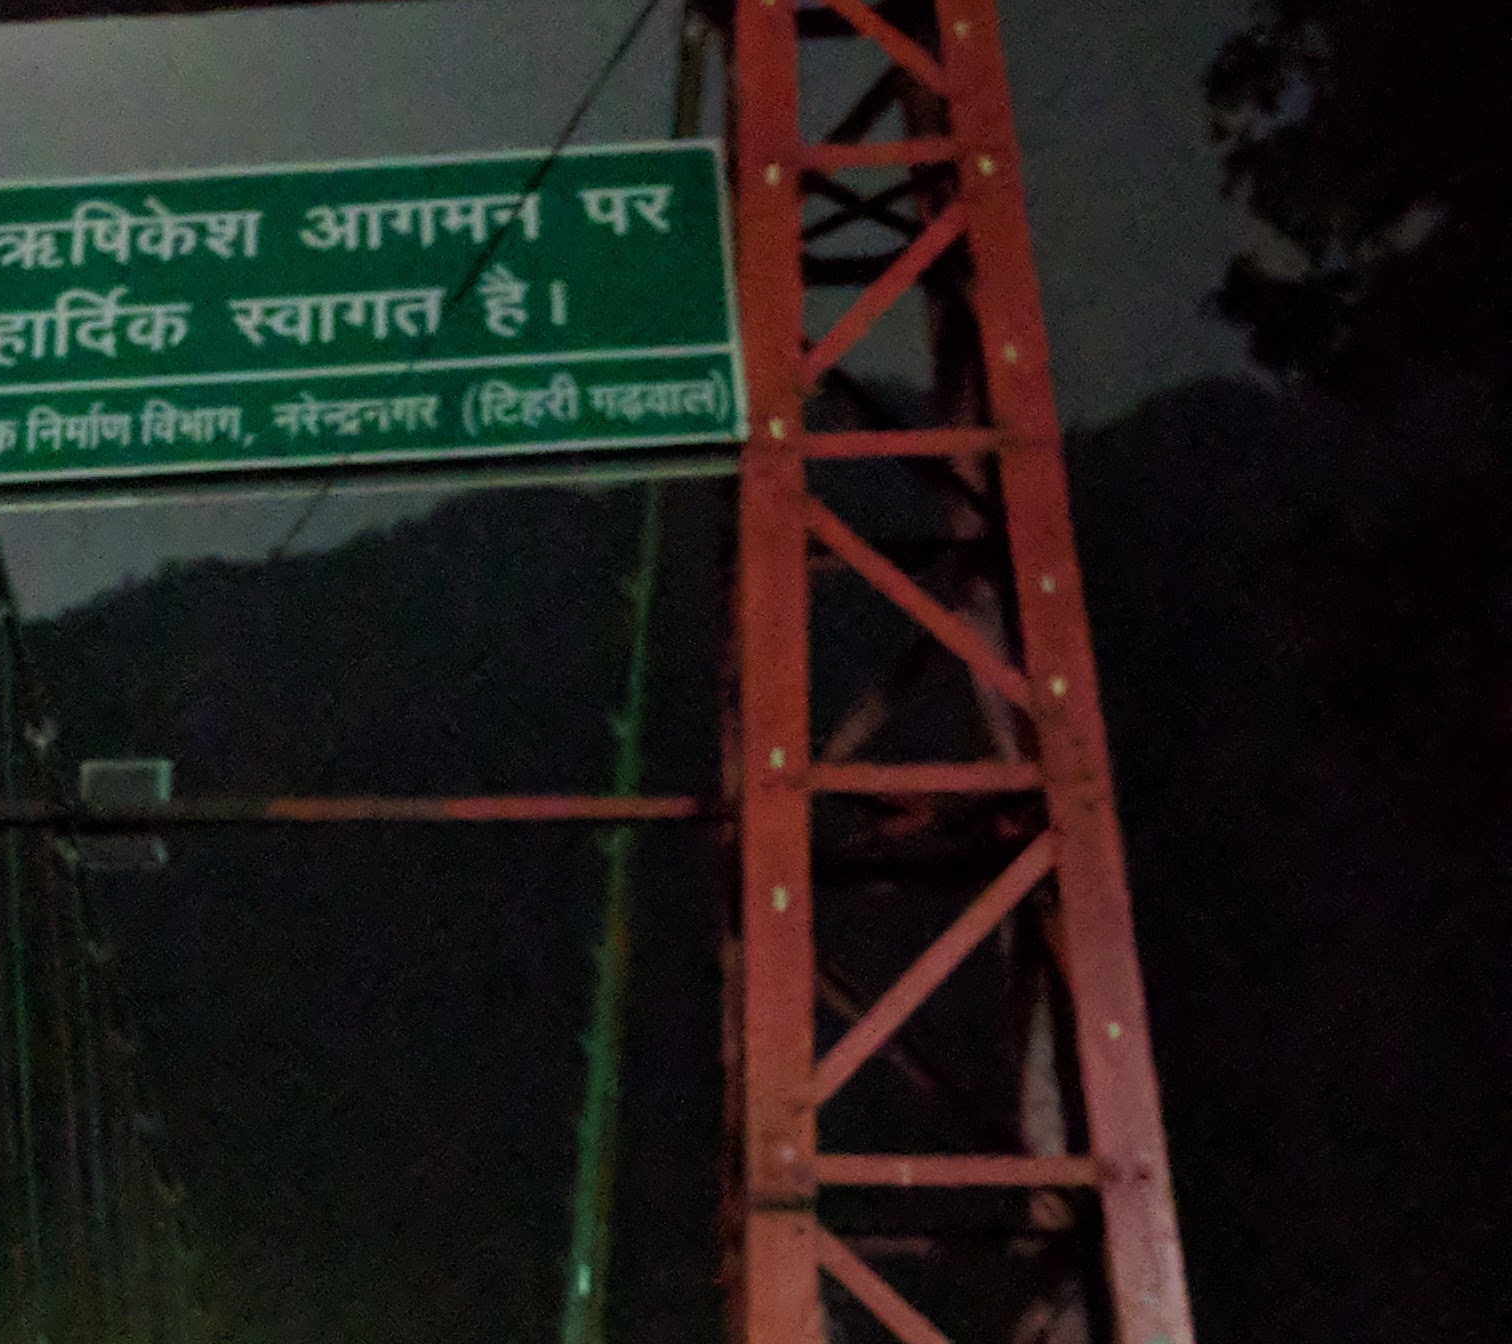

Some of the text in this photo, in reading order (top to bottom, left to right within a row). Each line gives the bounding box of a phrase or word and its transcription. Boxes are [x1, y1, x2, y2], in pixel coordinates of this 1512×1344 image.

[299, 193, 540, 249] आगमन
[580, 184, 672, 233] पर
[229, 287, 445, 345] स्वागत
[27, 402, 129, 451] निर्माण
[141, 399, 254, 447] विभाग,
